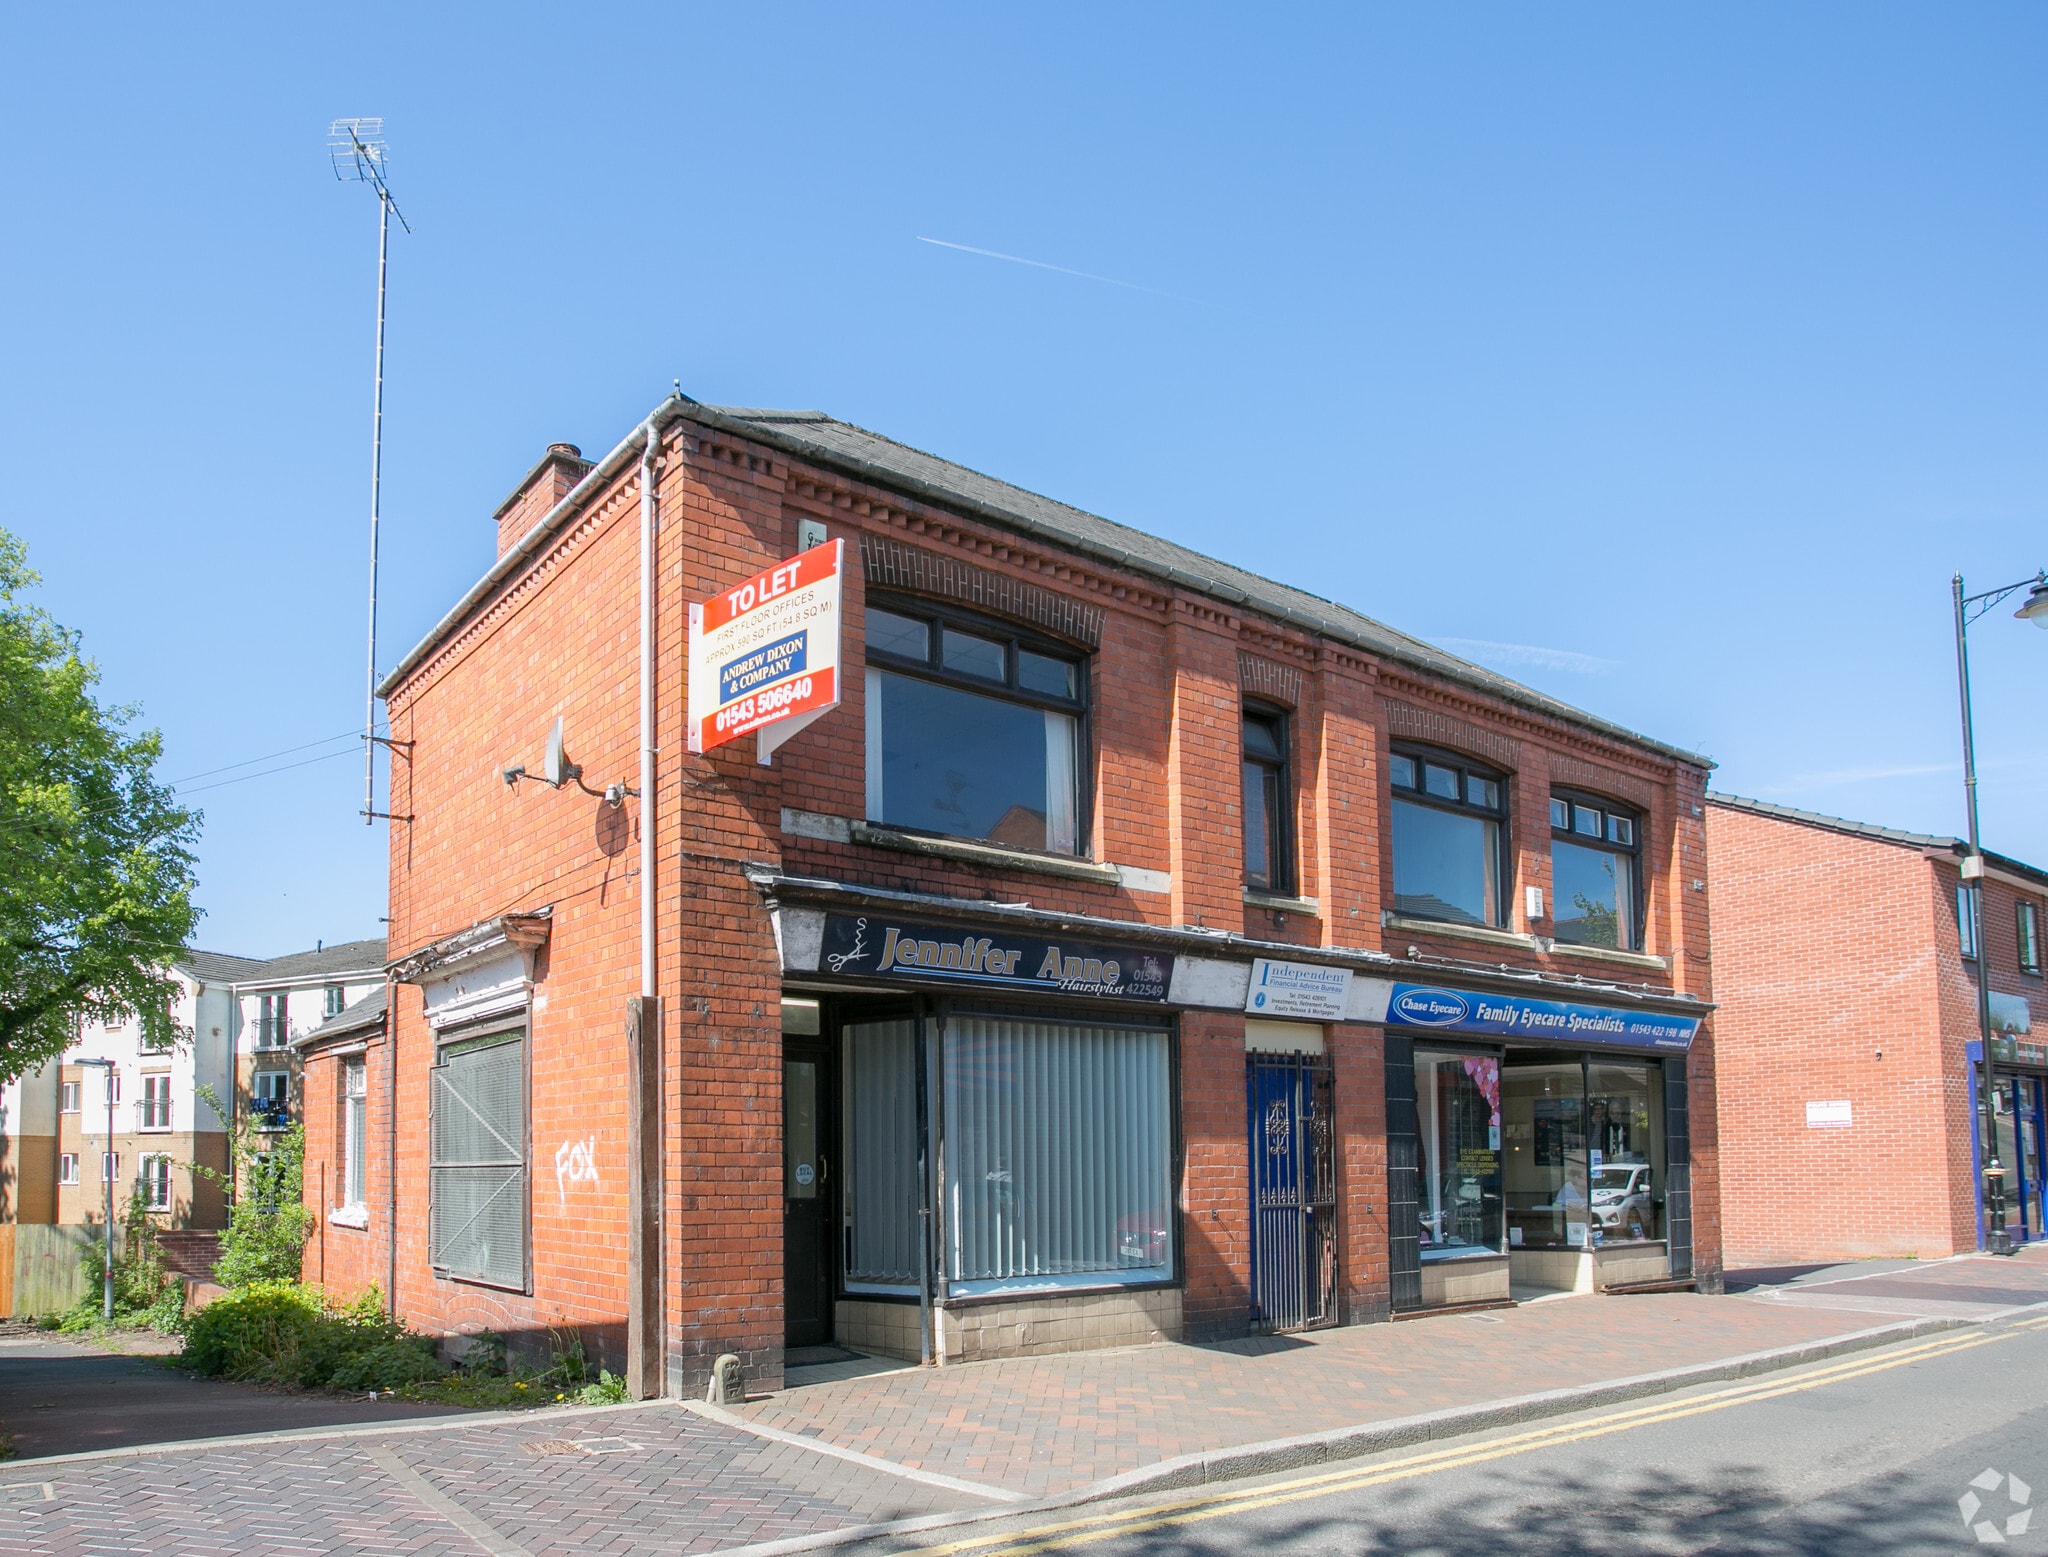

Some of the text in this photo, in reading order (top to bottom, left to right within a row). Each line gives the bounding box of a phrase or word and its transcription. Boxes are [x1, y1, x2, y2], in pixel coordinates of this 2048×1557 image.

[728, 560, 801, 617] TO LET
[717, 591, 814, 643] FIRST FLOOR OFFICES
[706, 644, 735, 664] APPROX
[753, 629, 764, 641] SQ
[767, 622, 777, 634] FT
[803, 607, 817, 619] SQ
[820, 601, 832, 613] M)
[722, 637, 803, 683] ANDREW DIXON
[730, 657, 792, 693] & COMPANY
[716, 677, 812, 732] 01543 506640
[876, 927, 1120, 984] Jennifer Anne
[1143, 956, 1159, 968] Tel:
[1058, 976, 1124, 996] Hairstylist
[1133, 969, 1162, 983] 01543
[1259, 962, 1344, 986] Independent
[1269, 979, 1343, 993] Financial Advice Bureau
[1126, 983, 1163, 997] 422549
[1401, 998, 1462, 1015] Chase Eyecare
[1476, 1003, 1625, 1033] Family Eyecare Specialists
[1630, 1023, 1692, 1038] 01543 422 198 NHS
[555, 1135, 600, 1205] FOX
